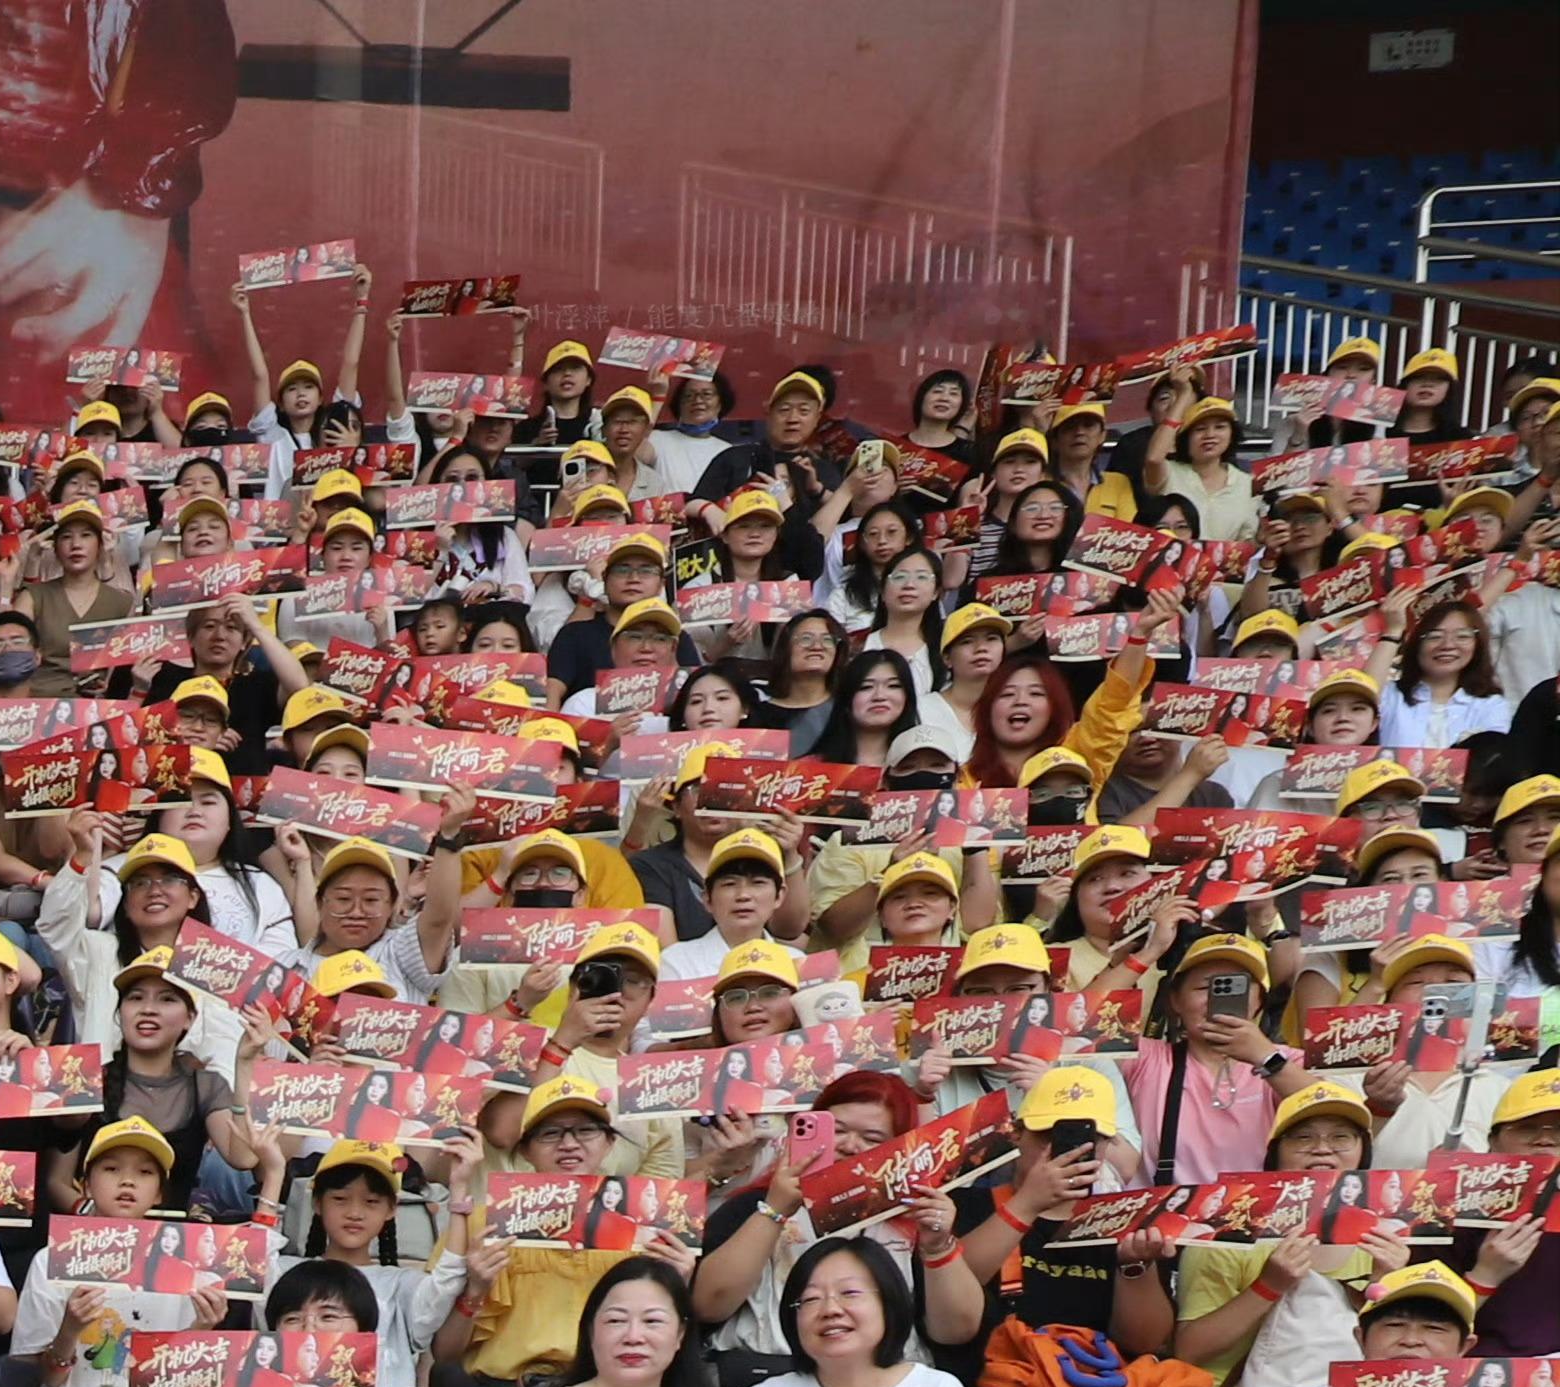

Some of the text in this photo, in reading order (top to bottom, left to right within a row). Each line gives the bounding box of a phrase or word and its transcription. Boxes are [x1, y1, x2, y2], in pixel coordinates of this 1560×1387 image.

[876, 1127, 959, 1201] 陈丽君
[146, 1336, 228, 1376] 开机大吉
